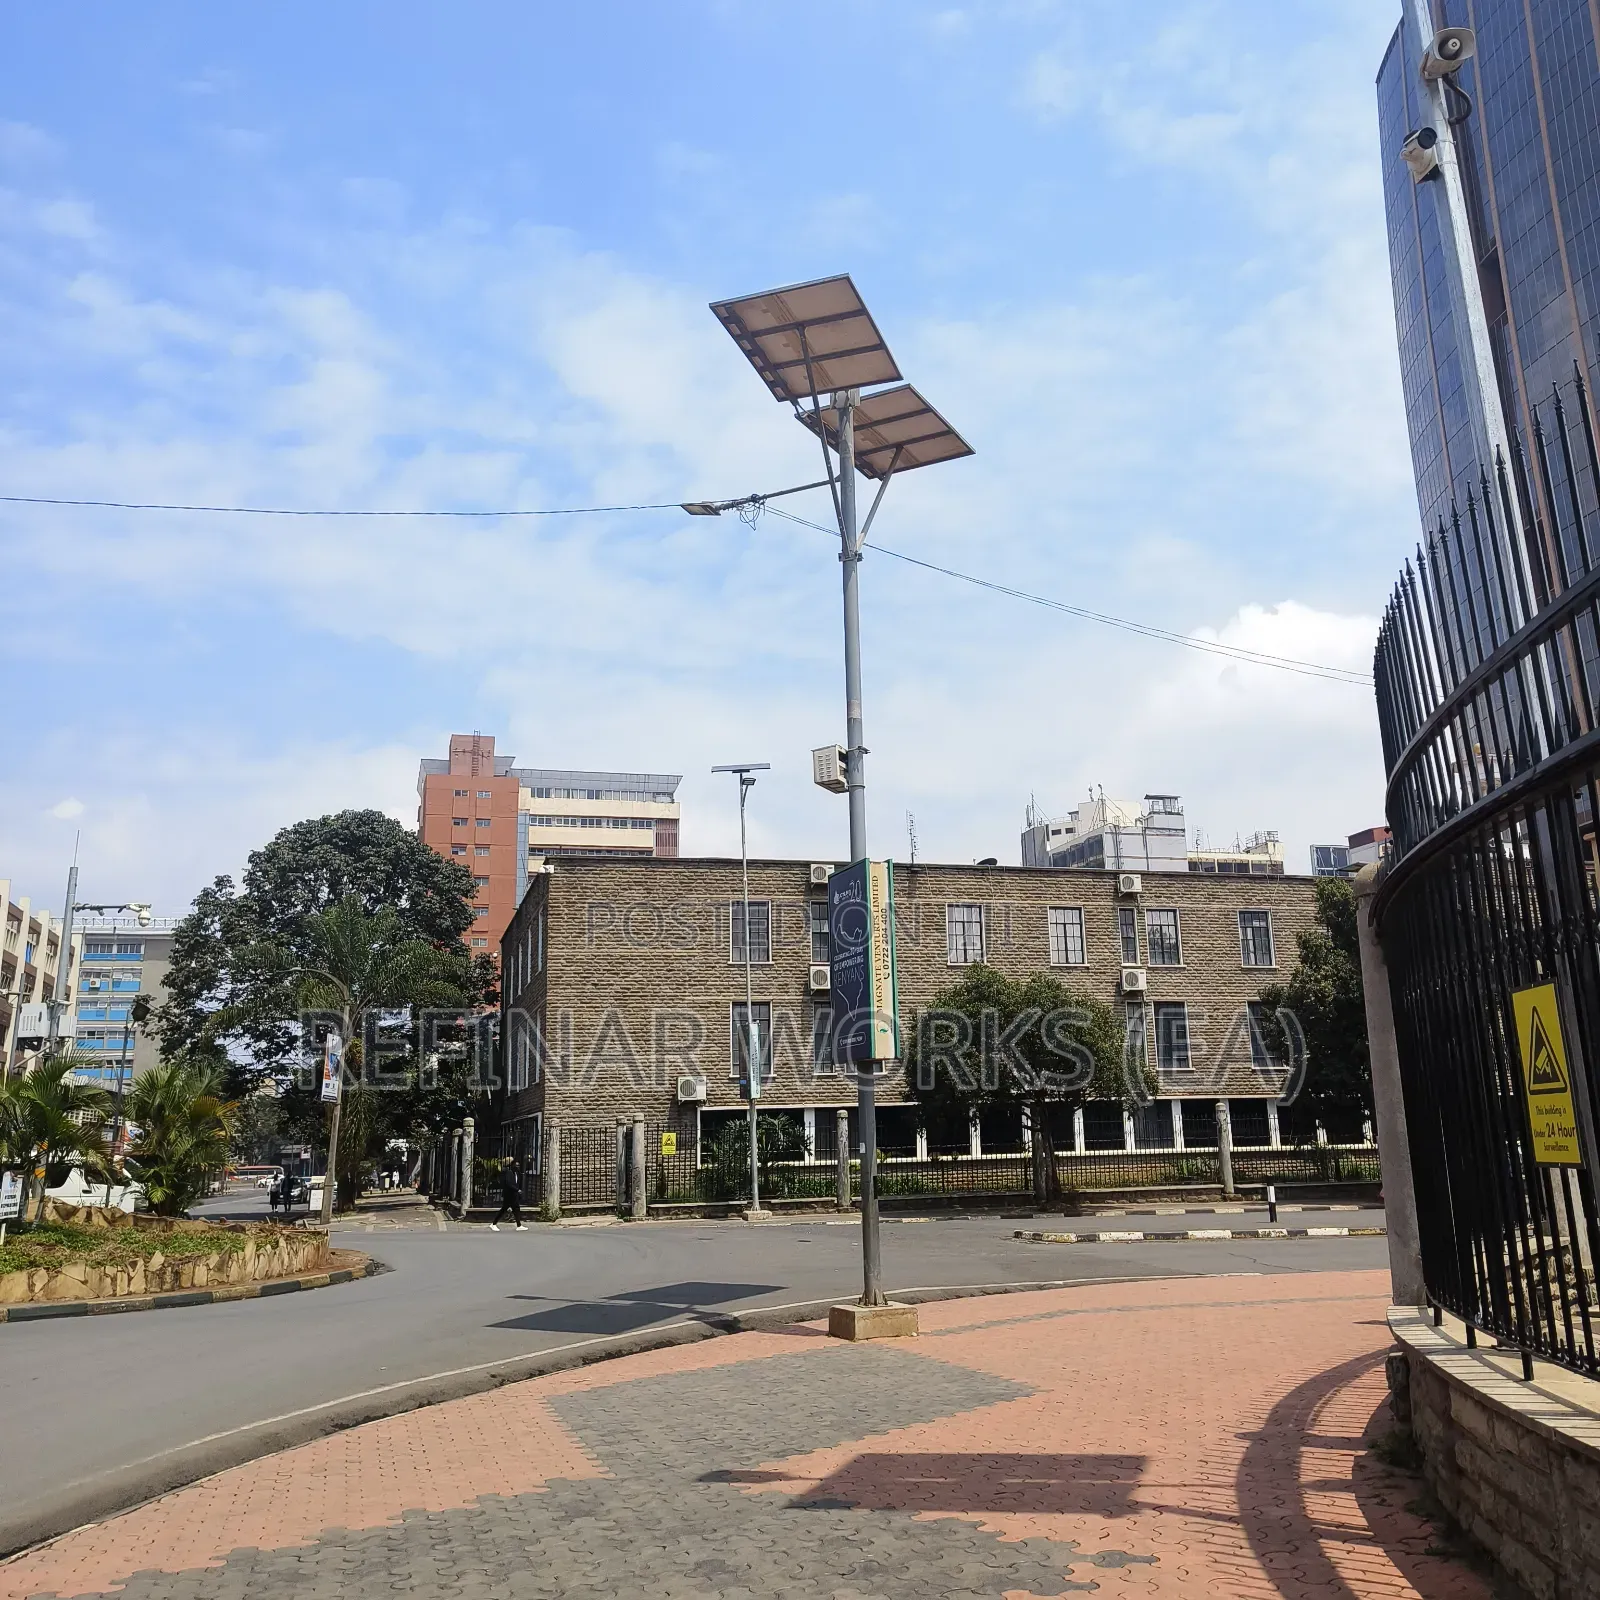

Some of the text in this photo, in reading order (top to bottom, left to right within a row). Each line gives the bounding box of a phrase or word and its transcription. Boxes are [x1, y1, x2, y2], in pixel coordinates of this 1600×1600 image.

[873, 914, 881, 963] VENTURES
[834, 964, 864, 988] KENYANS
[1546, 1121, 1556, 1138] 24
[1557, 1122, 1575, 1138] Hour
